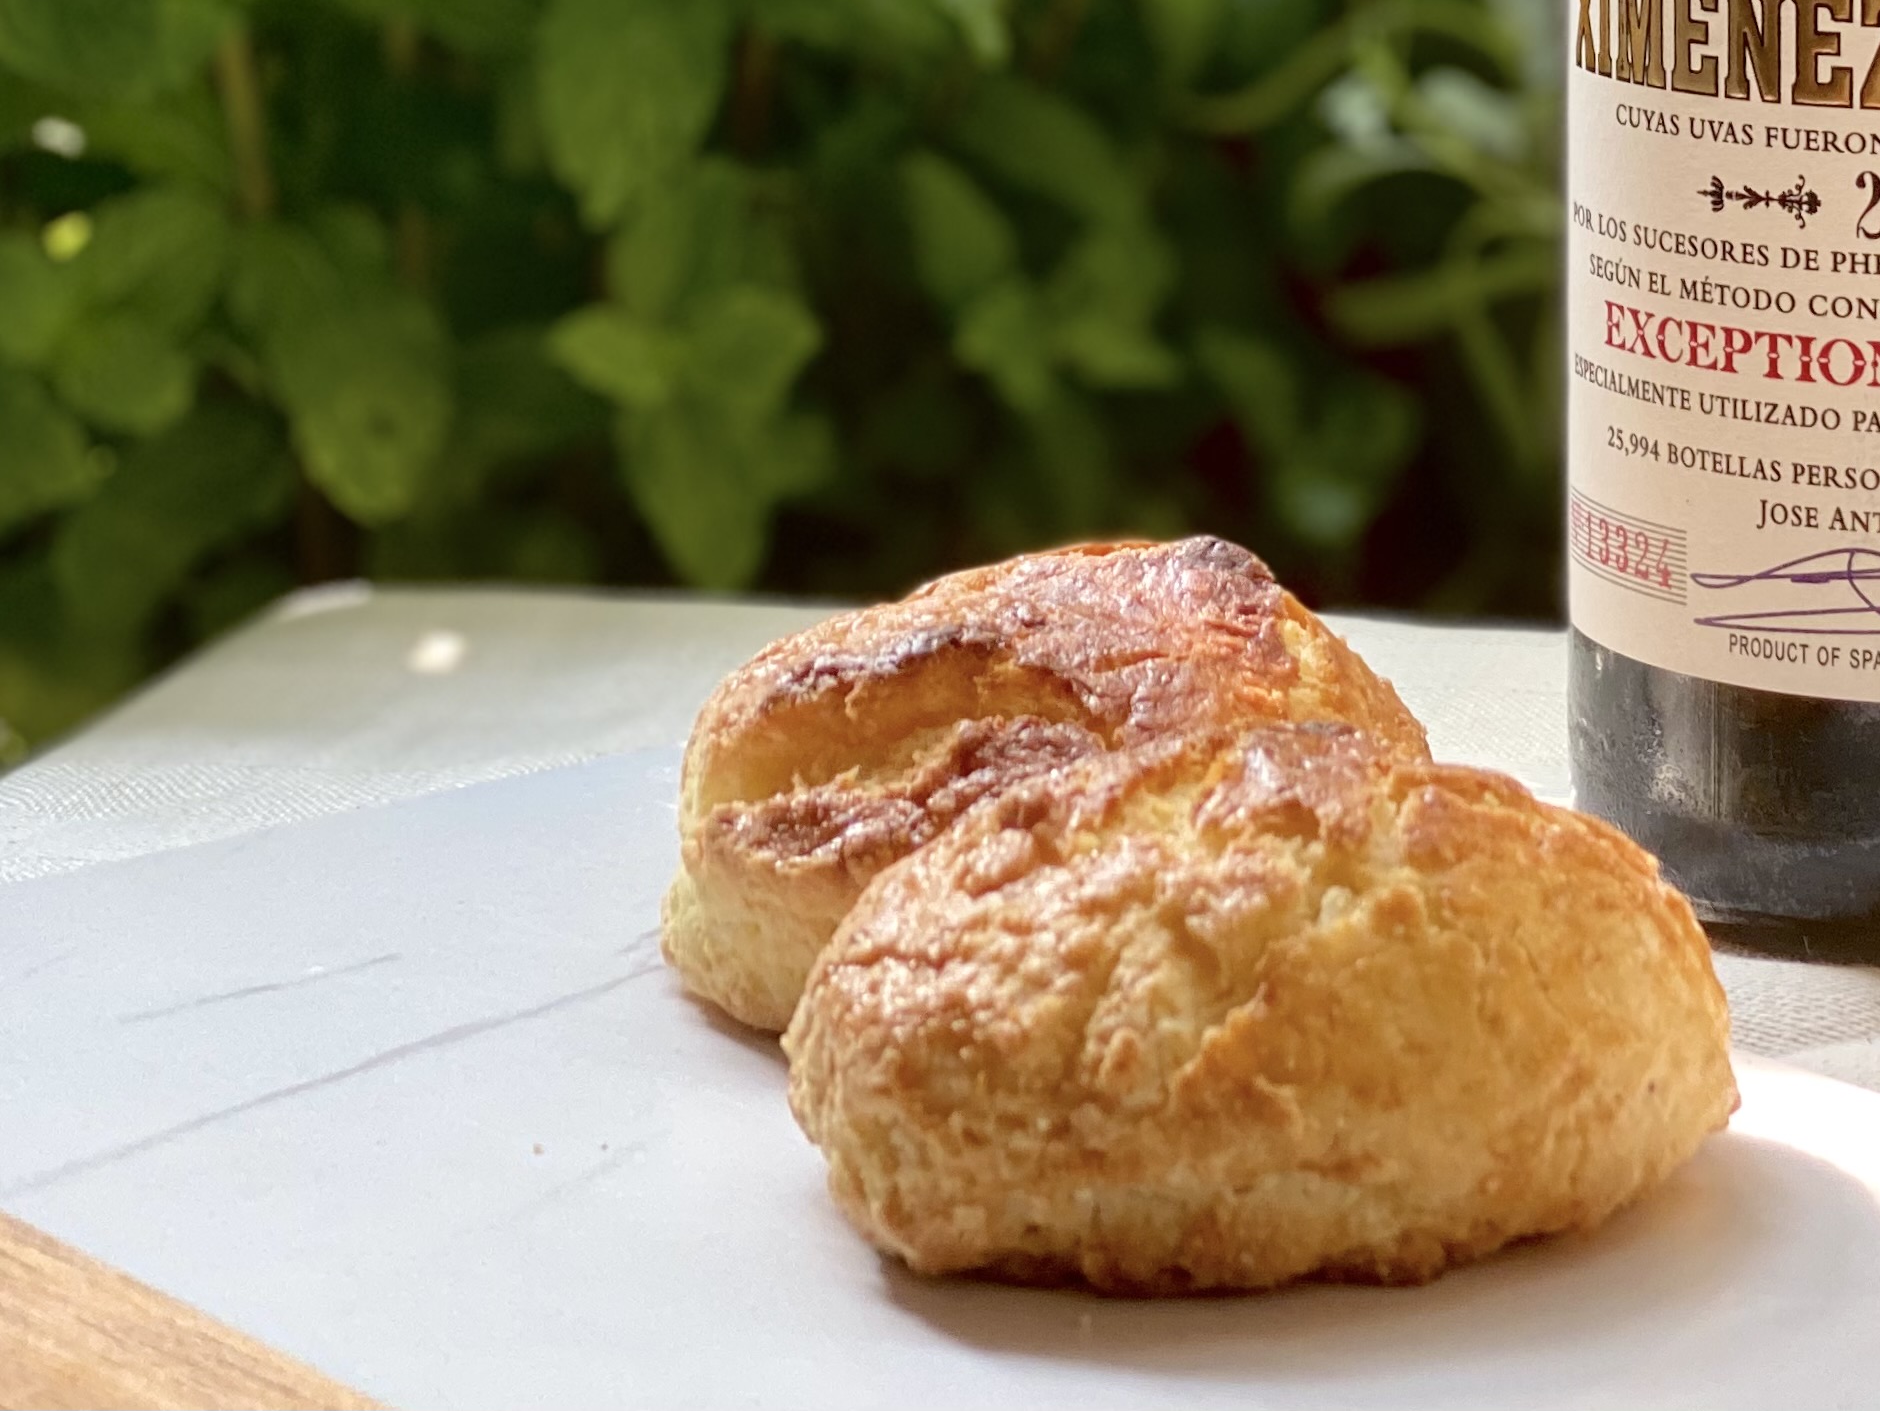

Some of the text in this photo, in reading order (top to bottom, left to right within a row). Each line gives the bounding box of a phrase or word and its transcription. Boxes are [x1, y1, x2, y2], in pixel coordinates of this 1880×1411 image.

[1616, 103, 1680, 136] CUYAS
[1689, 117, 1754, 146] UVAS
[1573, 201, 1595, 232] POR
[1598, 213, 1627, 243] LOS
[1633, 224, 1769, 267] SUCESORES
[1780, 247, 1820, 271] DE
[1589, 253, 1641, 290] SEGÚN
[1648, 271, 1672, 296] EL
[1679, 275, 1796, 315] MÉTODO
[1574, 352, 1691, 411] ESPECIALMENTE
[1699, 392, 1841, 431] UTILIZADO
[1607, 425, 1661, 462] 25,994
[1667, 443, 1781, 482] BOTELLAS
[1756, 500, 1819, 529] JOSE
[1728, 633, 1809, 665] PRODUCT
[1816, 640, 1841, 666] OF
